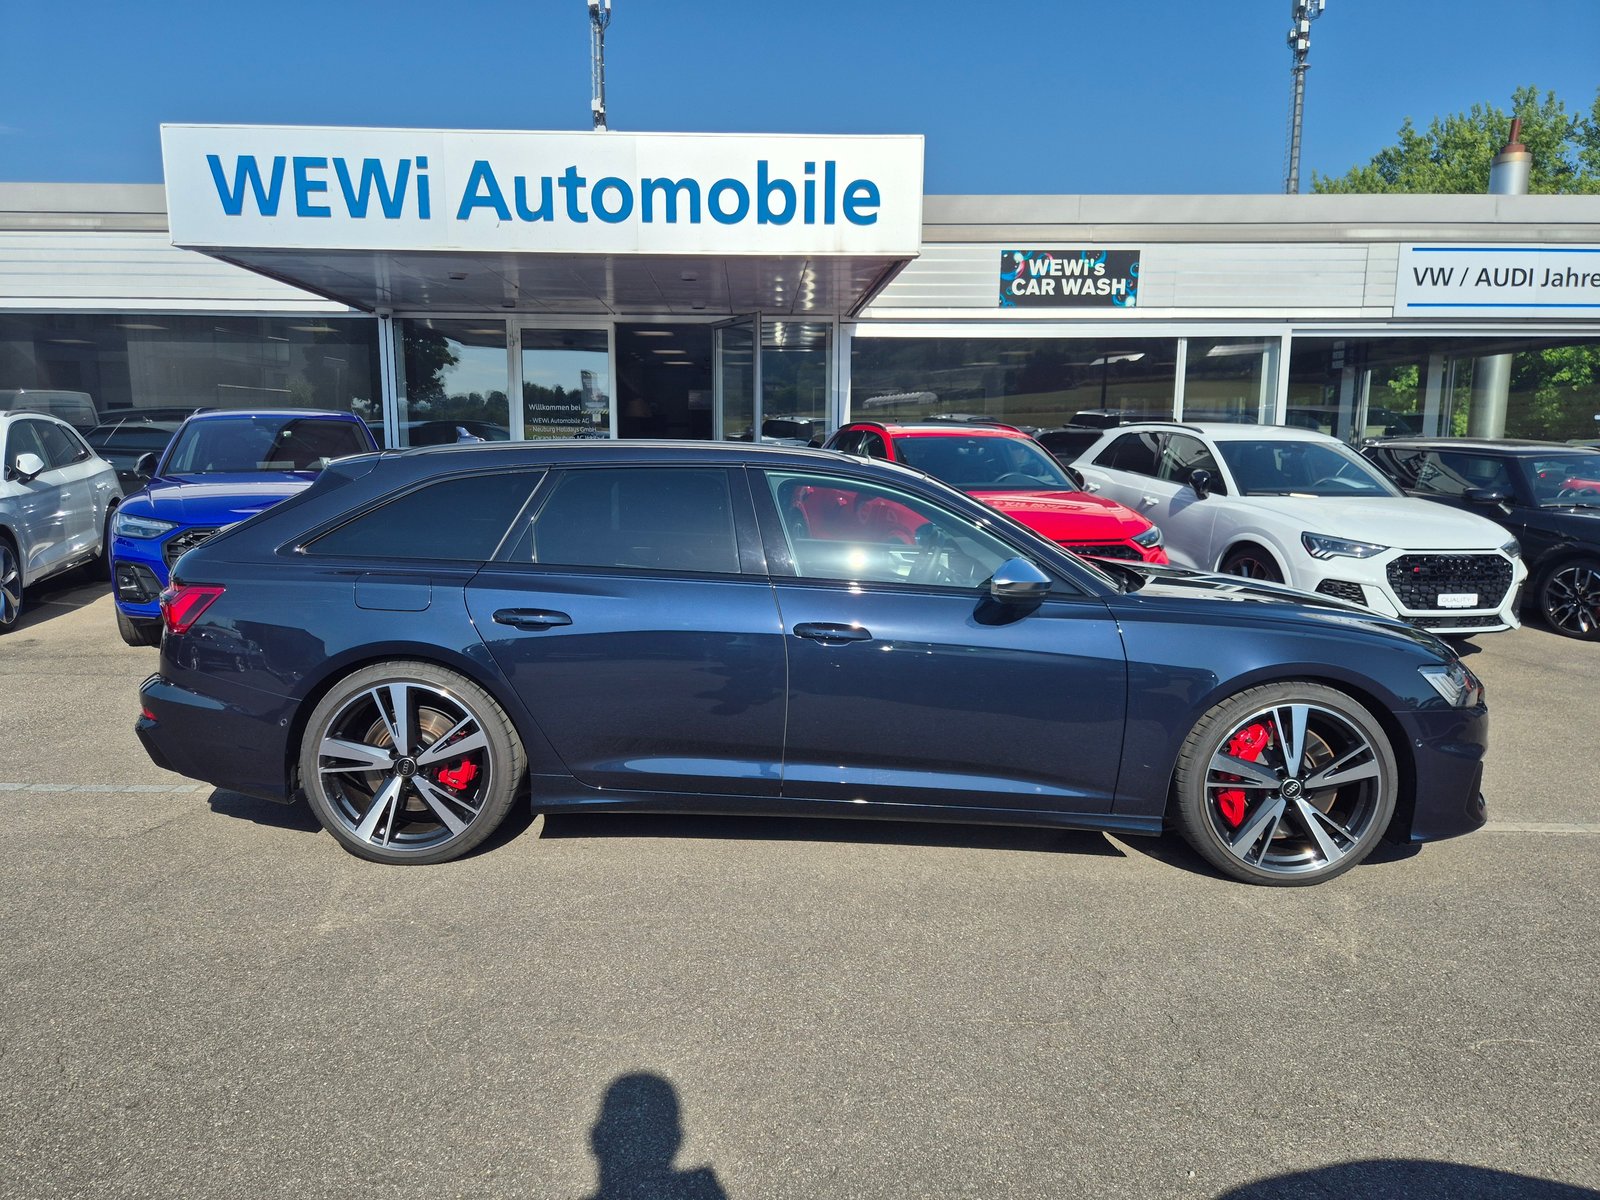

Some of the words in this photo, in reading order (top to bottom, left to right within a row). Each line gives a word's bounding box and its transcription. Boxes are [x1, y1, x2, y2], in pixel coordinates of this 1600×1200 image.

[207, 154, 430, 219] WEWi
[457, 160, 880, 224] Automobile
[1028, 258, 1106, 276] WEWi's
[1011, 278, 1055, 296] CAR
[1062, 278, 1126, 296] WASH
[1413, 267, 1454, 287] VW
[1459, 267, 1469, 287] /
[1475, 267, 1534, 287] AUDI
[1540, 267, 1600, 288] Jahre
